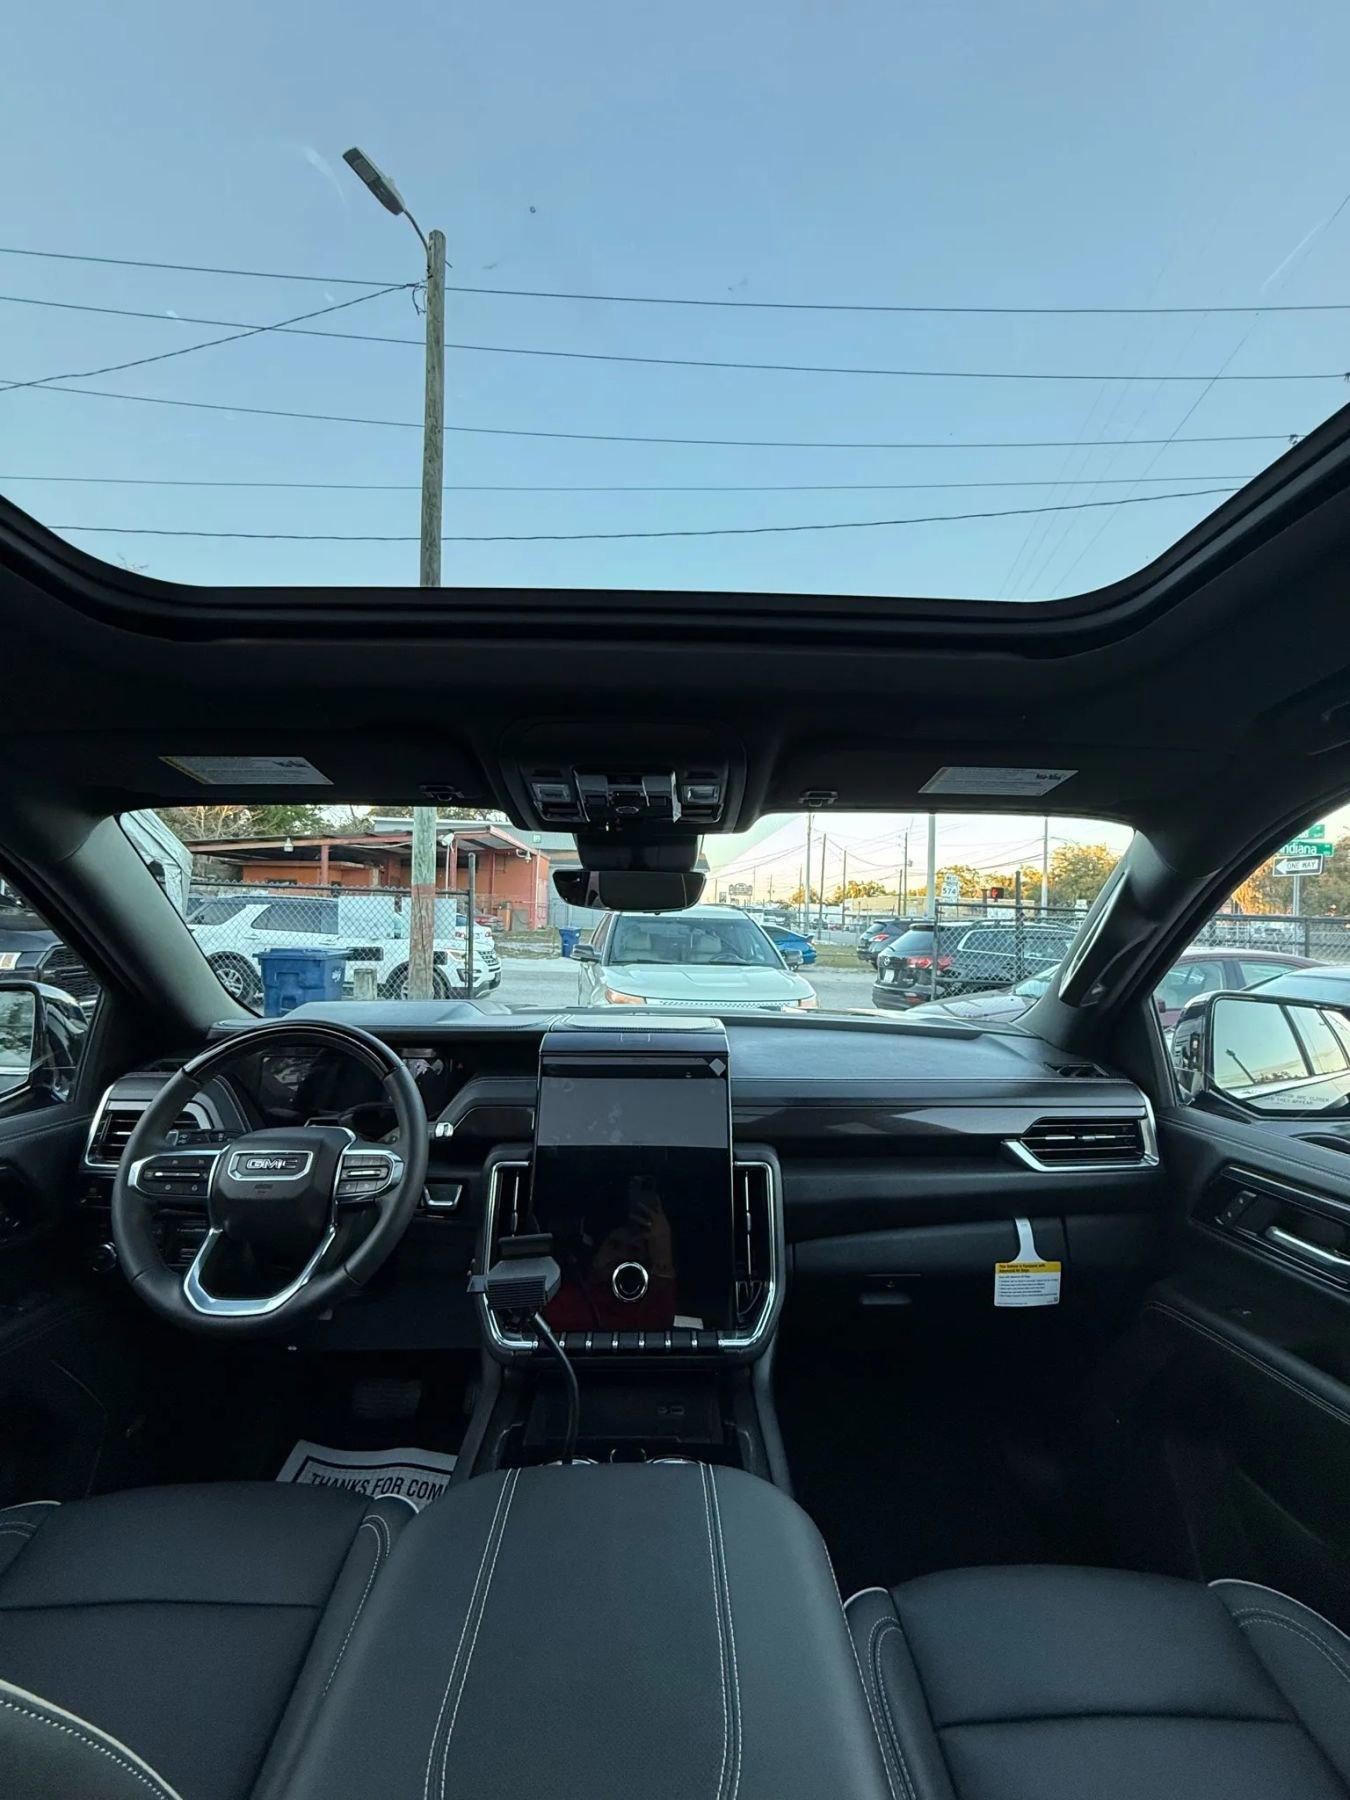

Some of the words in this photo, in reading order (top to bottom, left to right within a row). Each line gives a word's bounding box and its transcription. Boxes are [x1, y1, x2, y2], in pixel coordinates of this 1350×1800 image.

[1287, 862, 1300, 870] ONE
[1302, 861, 1316, 869] WAY
[247, 1158, 298, 1169] GMC
[371, 1477, 405, 1495] FOR
